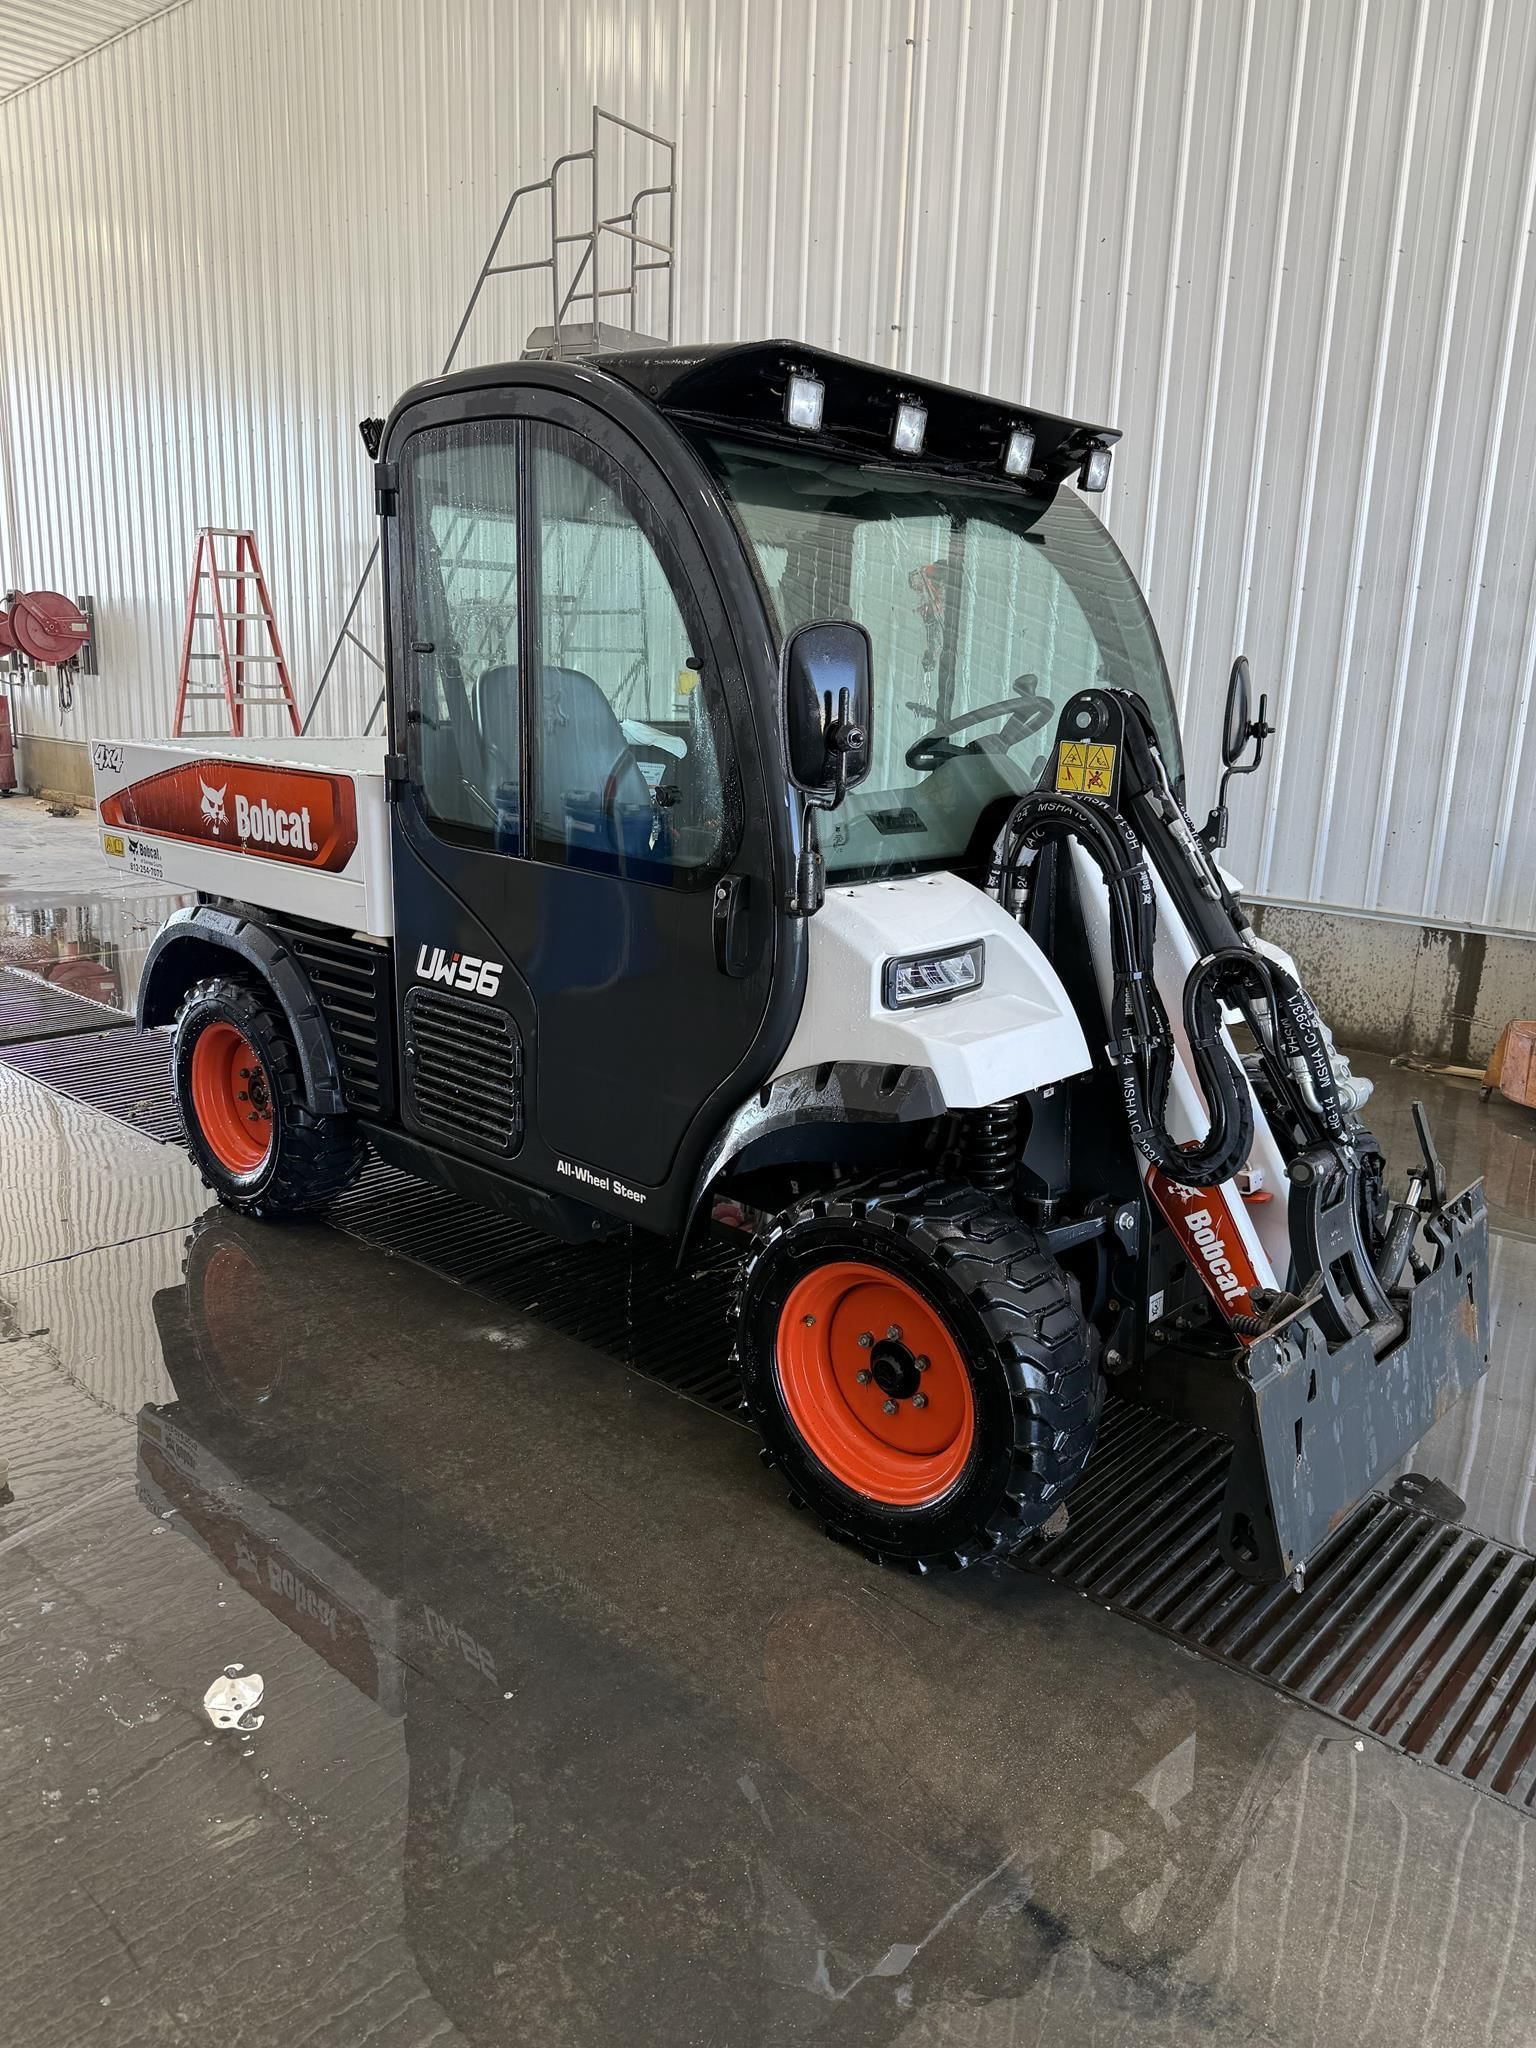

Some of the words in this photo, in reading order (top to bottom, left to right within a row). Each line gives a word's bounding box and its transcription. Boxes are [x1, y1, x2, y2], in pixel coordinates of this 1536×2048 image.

[94, 744, 125, 773] 4x4
[234, 794, 314, 851] Bobcat
[1037, 802, 1074, 815] MSHA
[138, 842, 161, 860] Bobcat
[416, 943, 504, 998] UW56
[1287, 994, 1317, 1050] IC-293/1
[1312, 1048, 1332, 1088] MSHA
[1122, 1077, 1138, 1119] MSHA
[1324, 1096, 1342, 1131] HG-14
[556, 1160, 611, 1192] All-Wheel
[613, 1180, 647, 1204] Steer
[1184, 1208, 1249, 1303] Bobcat
